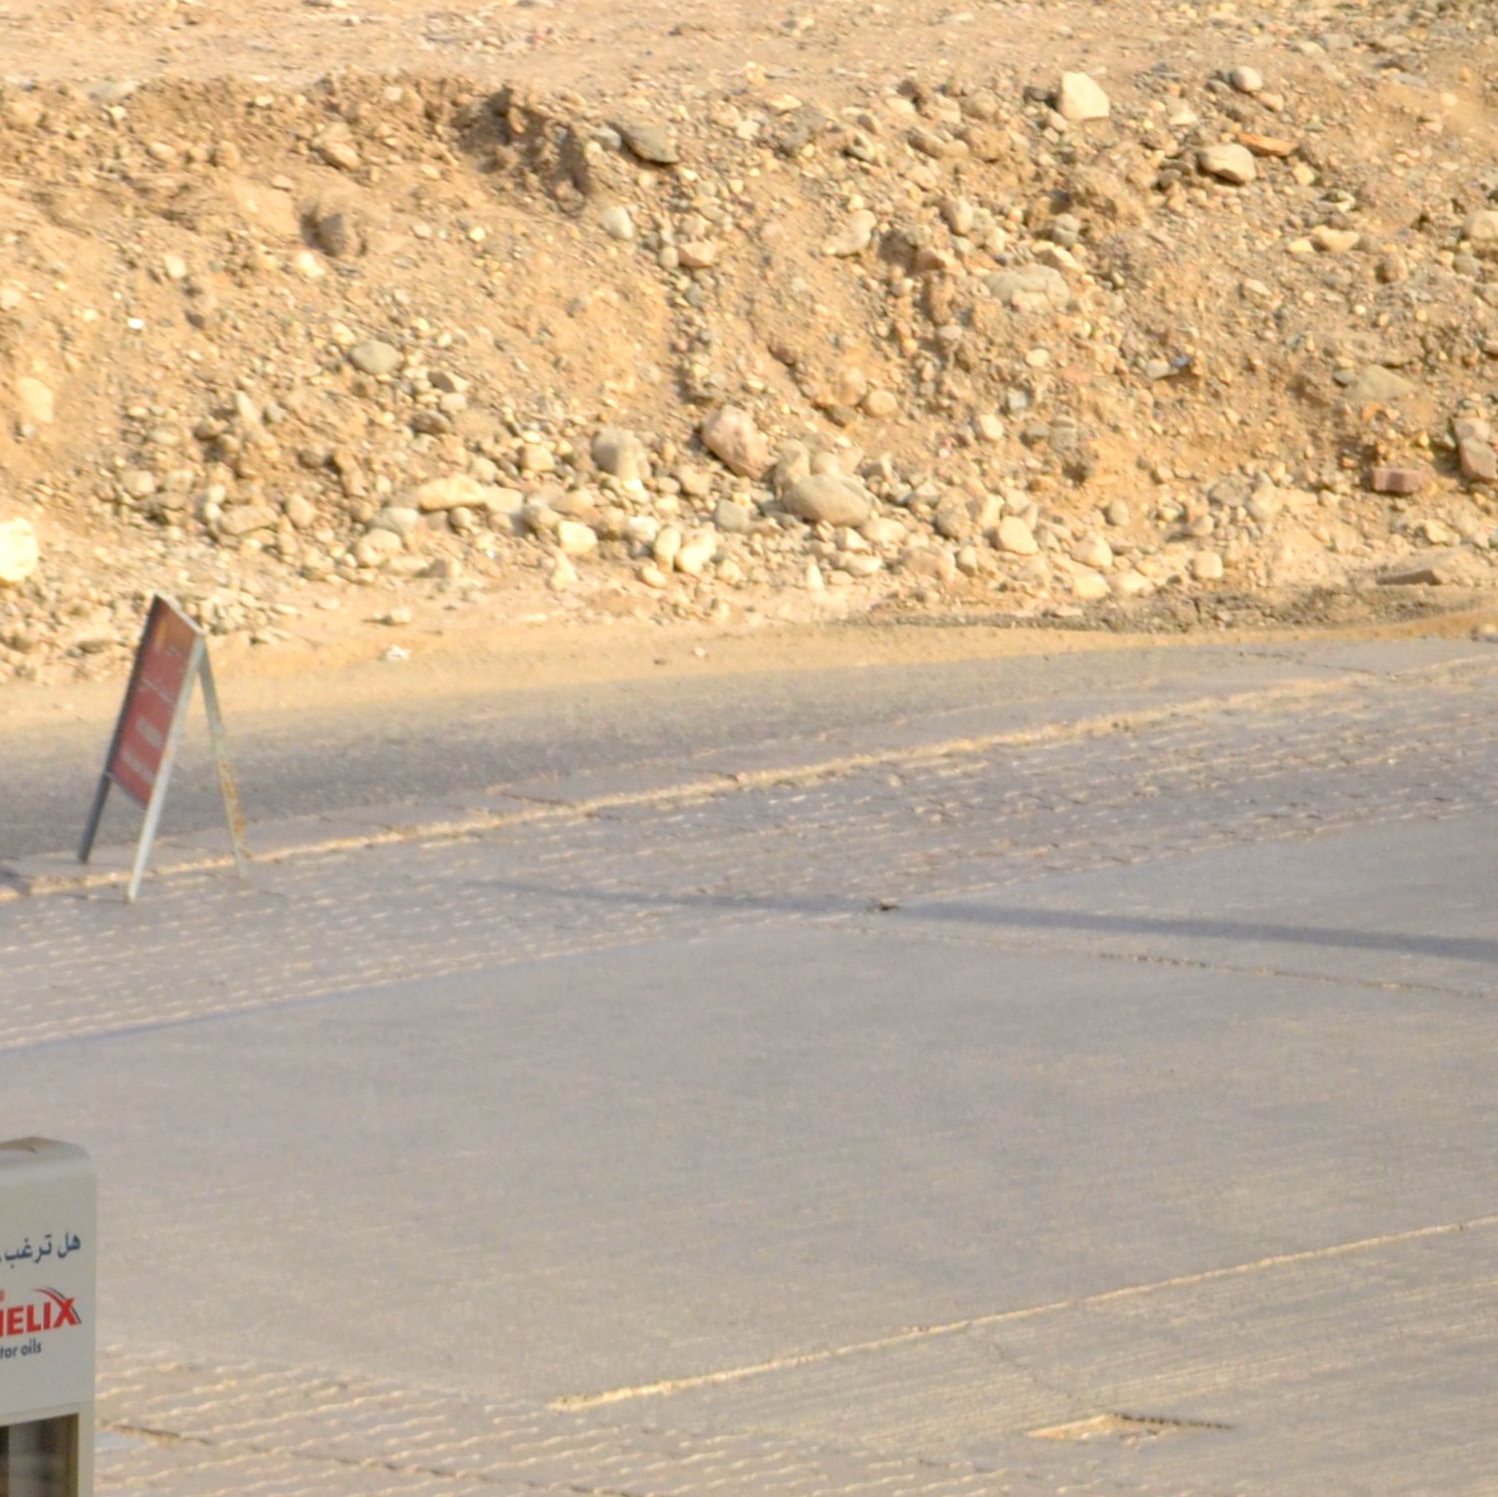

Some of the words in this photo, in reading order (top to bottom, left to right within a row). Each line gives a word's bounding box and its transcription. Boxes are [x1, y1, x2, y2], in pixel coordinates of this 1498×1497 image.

[4, 1233, 52, 1268] ترغب
[57, 1232, 82, 1258] هل
[20, 1338, 43, 1356] oils
